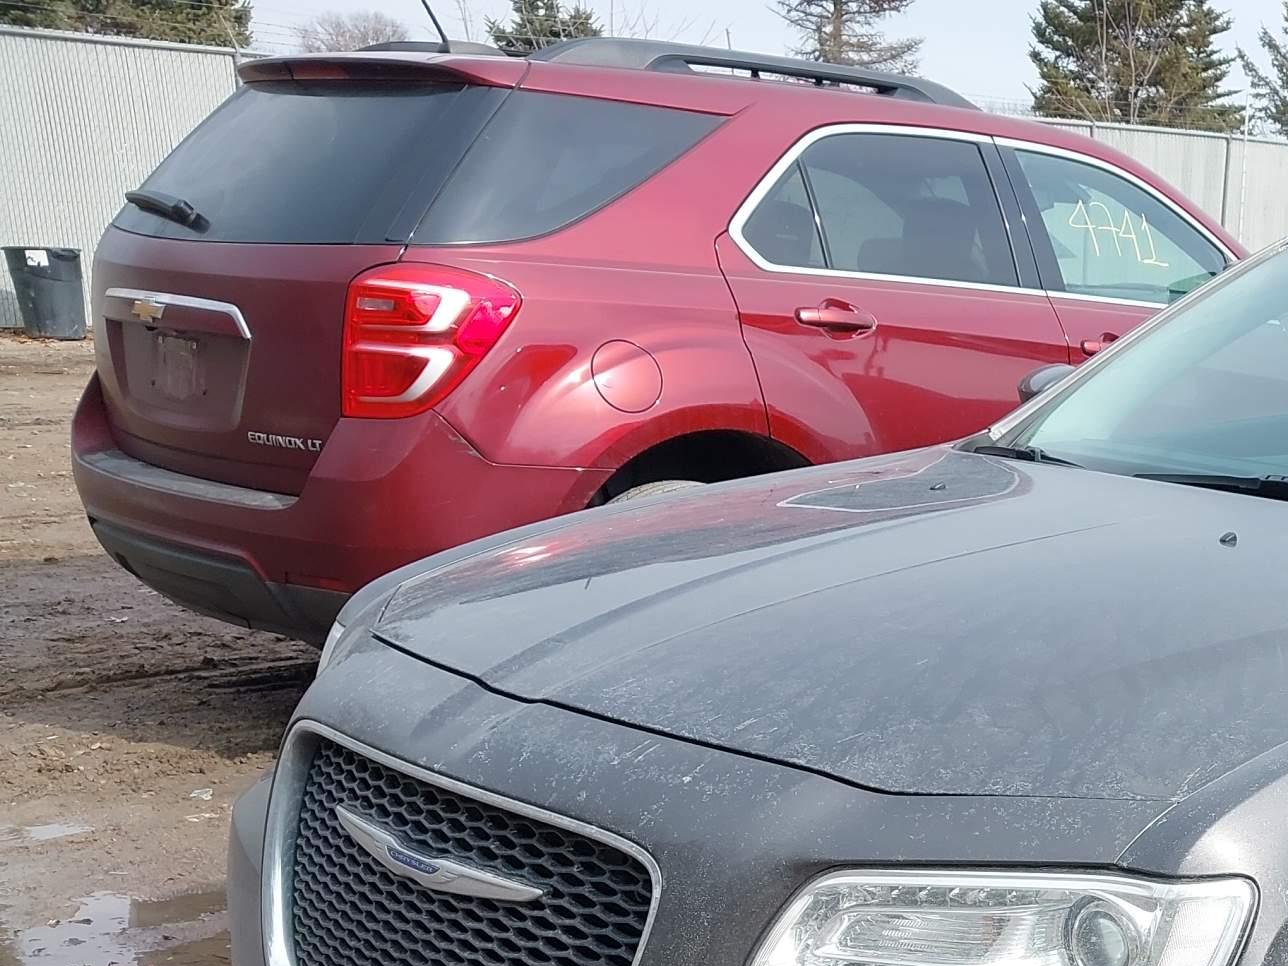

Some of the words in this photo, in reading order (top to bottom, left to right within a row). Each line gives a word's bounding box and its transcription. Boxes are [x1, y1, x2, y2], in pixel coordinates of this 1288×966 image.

[1068, 199, 1169, 267] 4741
[247, 431, 305, 450] EQUINOX
[307, 439, 322, 451] LT
[390, 850, 434, 873] CHRYSLER
